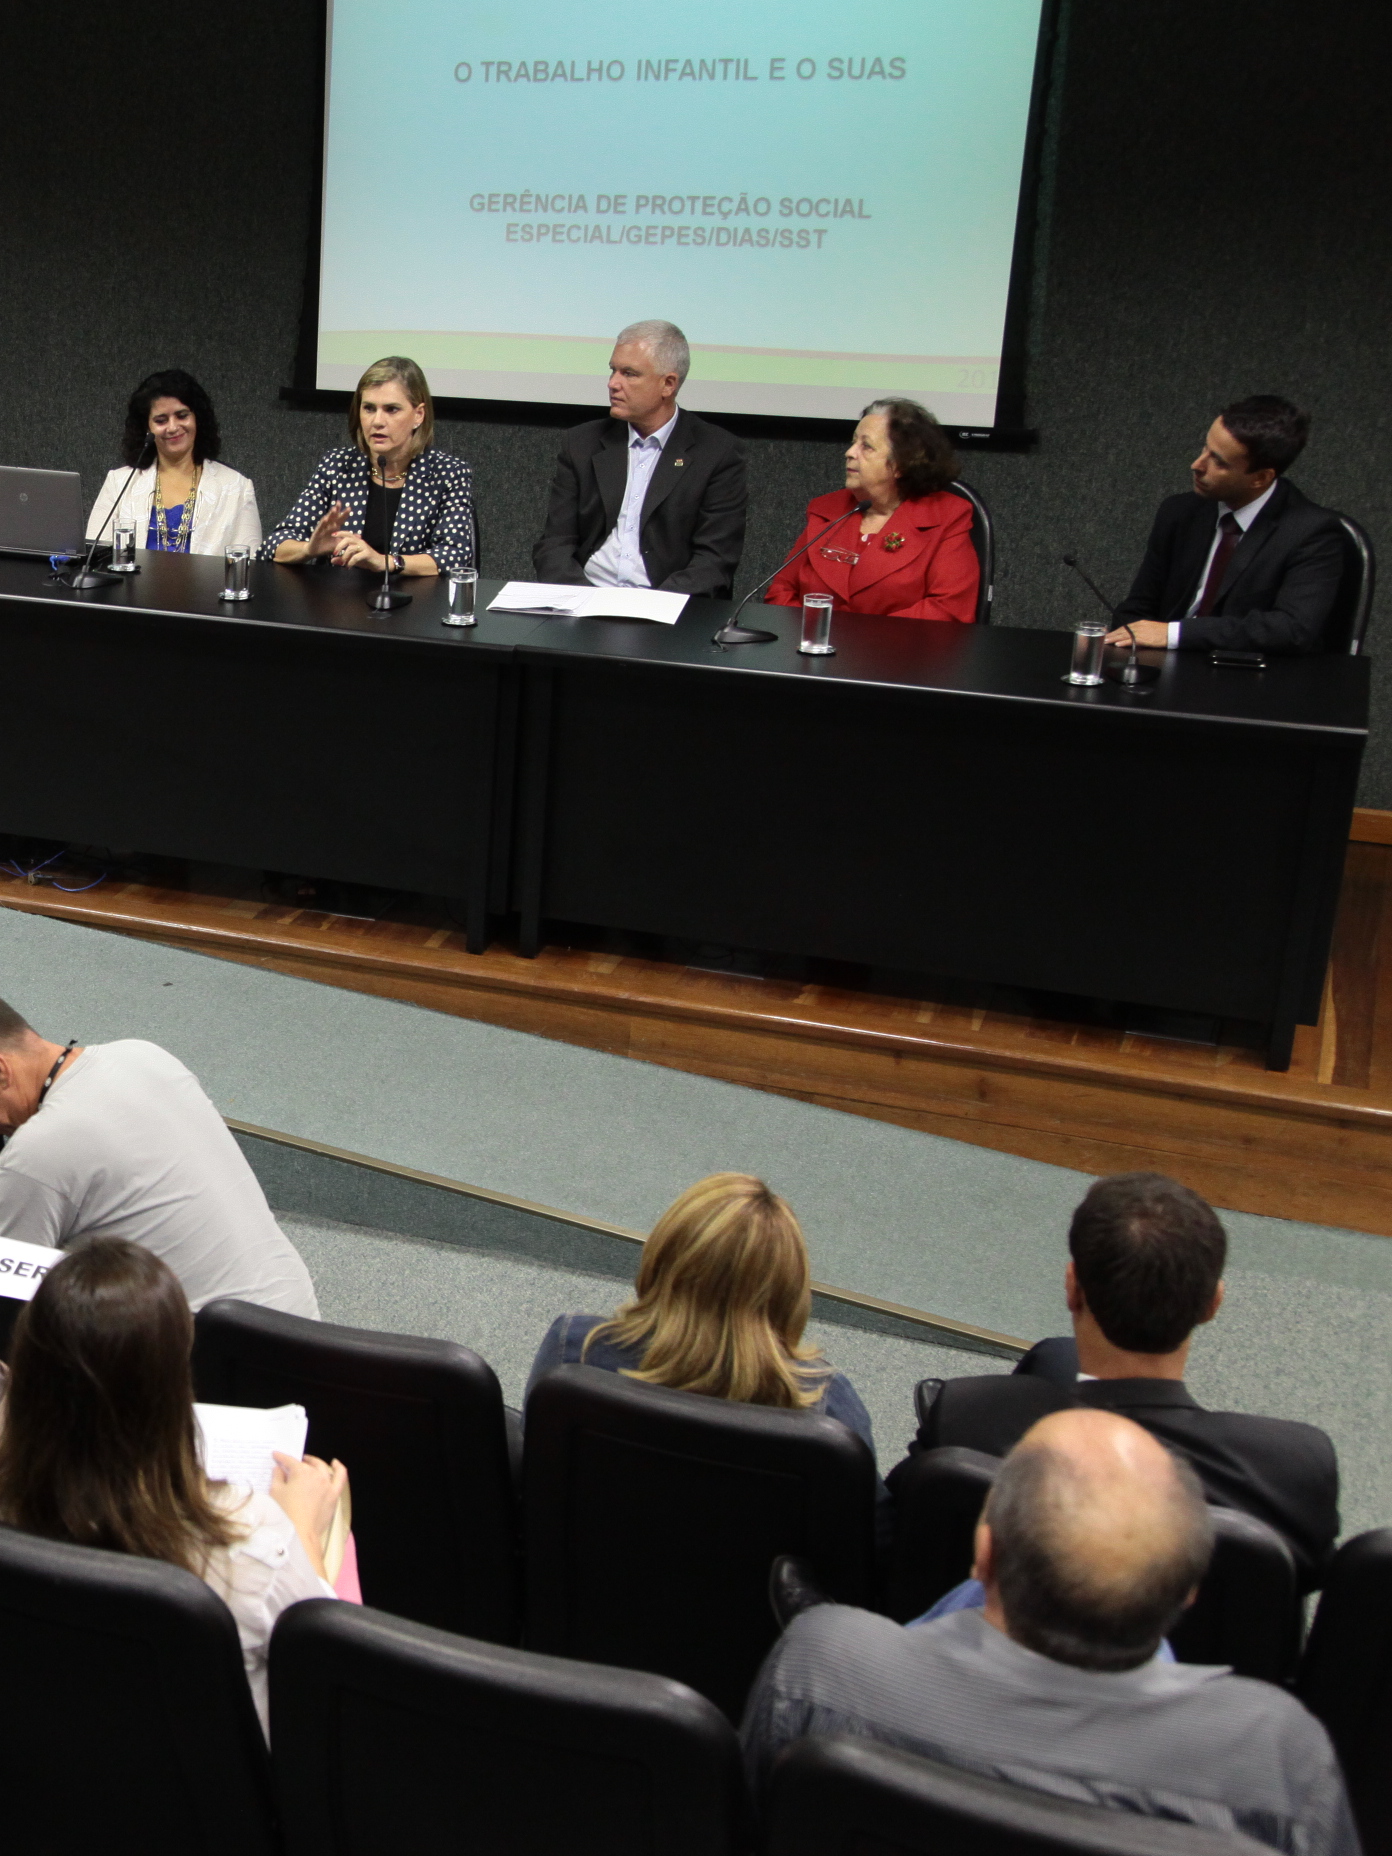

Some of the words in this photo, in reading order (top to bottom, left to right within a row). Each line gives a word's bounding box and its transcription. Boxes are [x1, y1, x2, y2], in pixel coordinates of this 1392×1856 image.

[453, 61, 473, 83] O
[480, 59, 626, 83] TRABALHO
[636, 58, 759, 82] INFANTIL
[769, 57, 786, 81] E
[795, 57, 817, 80] O
[826, 56, 907, 80] SUAS
[469, 189, 589, 214] GERÊNCIA
[595, 194, 628, 215] DE
[635, 192, 772, 221] PROTEÇÃO
[778, 197, 872, 219] SOCIAL
[505, 222, 829, 250] ESPECIAL/GEPES/DIAS/SST
[957, 368, 997, 391] 201
